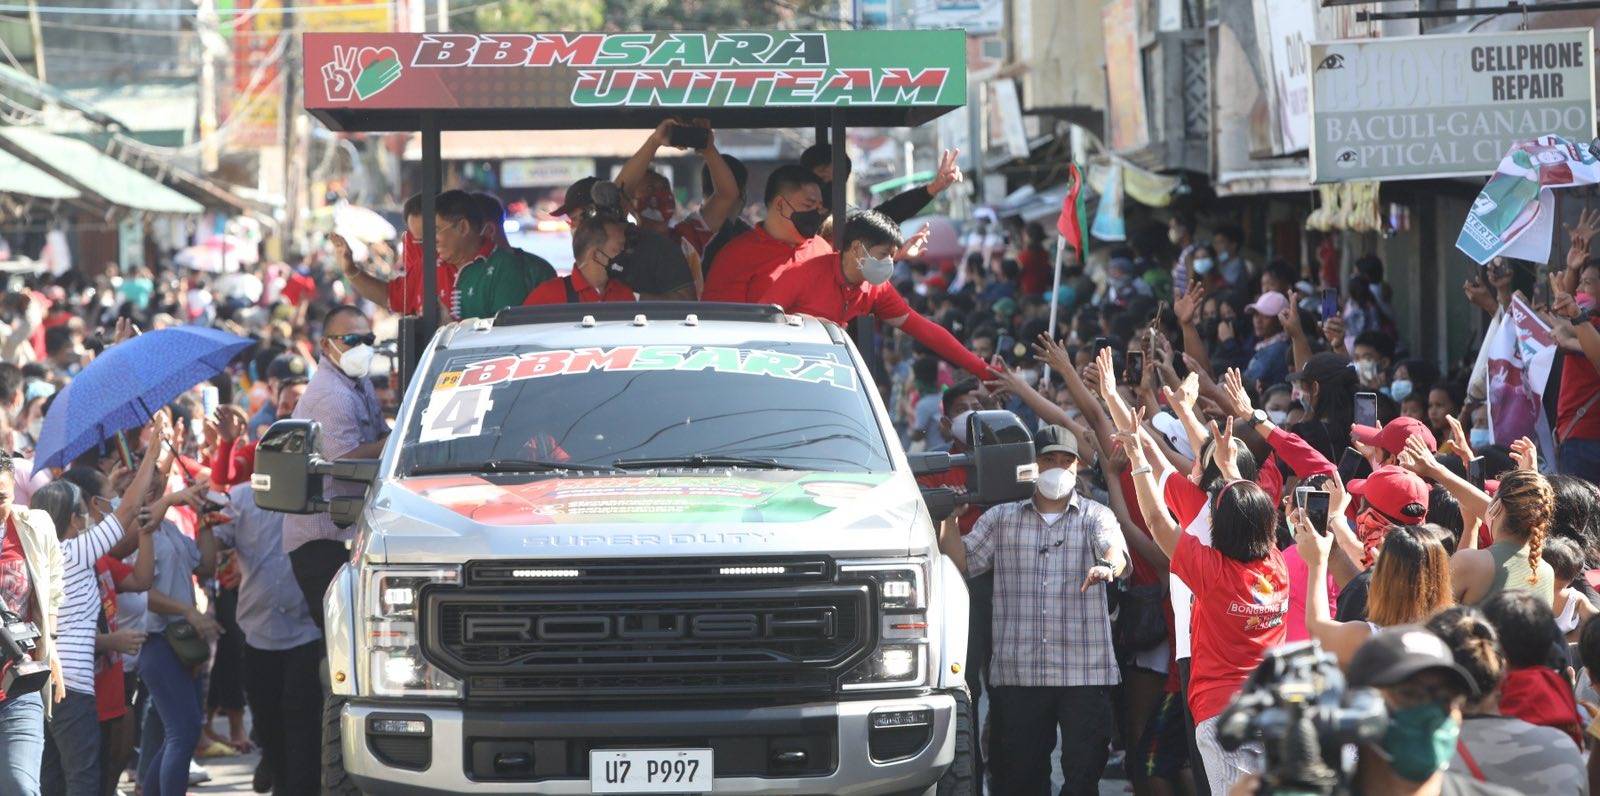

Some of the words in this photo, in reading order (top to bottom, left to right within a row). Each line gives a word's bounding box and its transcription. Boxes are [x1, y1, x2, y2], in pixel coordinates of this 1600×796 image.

[411, 33, 830, 67] BBMSARA
[1471, 41, 1584, 73] CELLPHONE
[570, 67, 950, 107] UNITEAM
[1492, 73, 1564, 101] REPAIR
[1326, 106, 1587, 143] BACULI-GANADO
[459, 345, 858, 392] BBMSARA
[430, 388, 480, 435] 4
[522, 534, 661, 547] SUPER
[668, 531, 776, 545] DUTY
[465, 611, 834, 642] ROUSH
[605, 759, 632, 784] U7
[646, 759, 700, 784] P997
